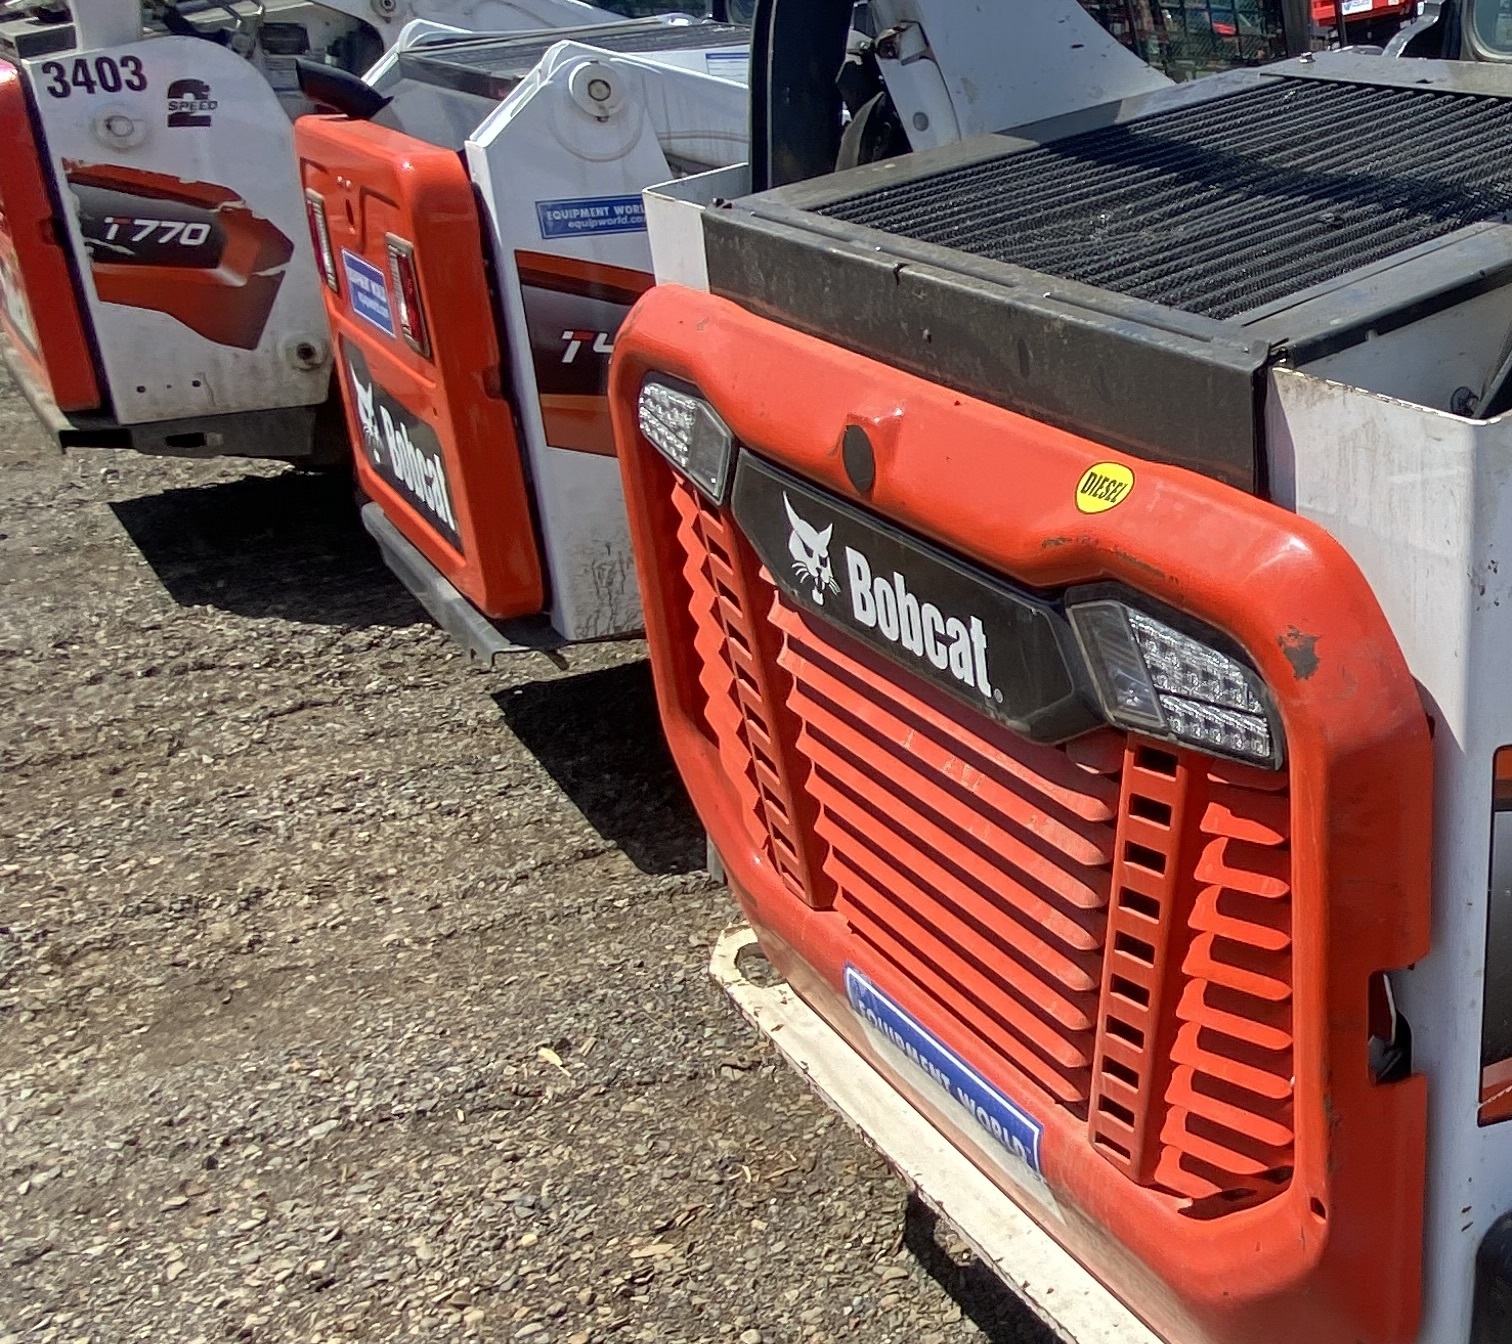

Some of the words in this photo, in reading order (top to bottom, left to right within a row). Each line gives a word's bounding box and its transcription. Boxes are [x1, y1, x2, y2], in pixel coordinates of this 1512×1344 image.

[42, 55, 148, 98] 3403
[168, 100, 218, 111] SPEED
[546, 206, 610, 221] EQUIPMENT
[614, 204, 646, 216] WORL
[567, 214, 647, 229] equipworld.co
[104, 216, 212, 246] T770
[380, 405, 456, 531] Bobcat
[1080, 471, 1128, 503] DIESEL
[845, 545, 992, 698] Bobcat
